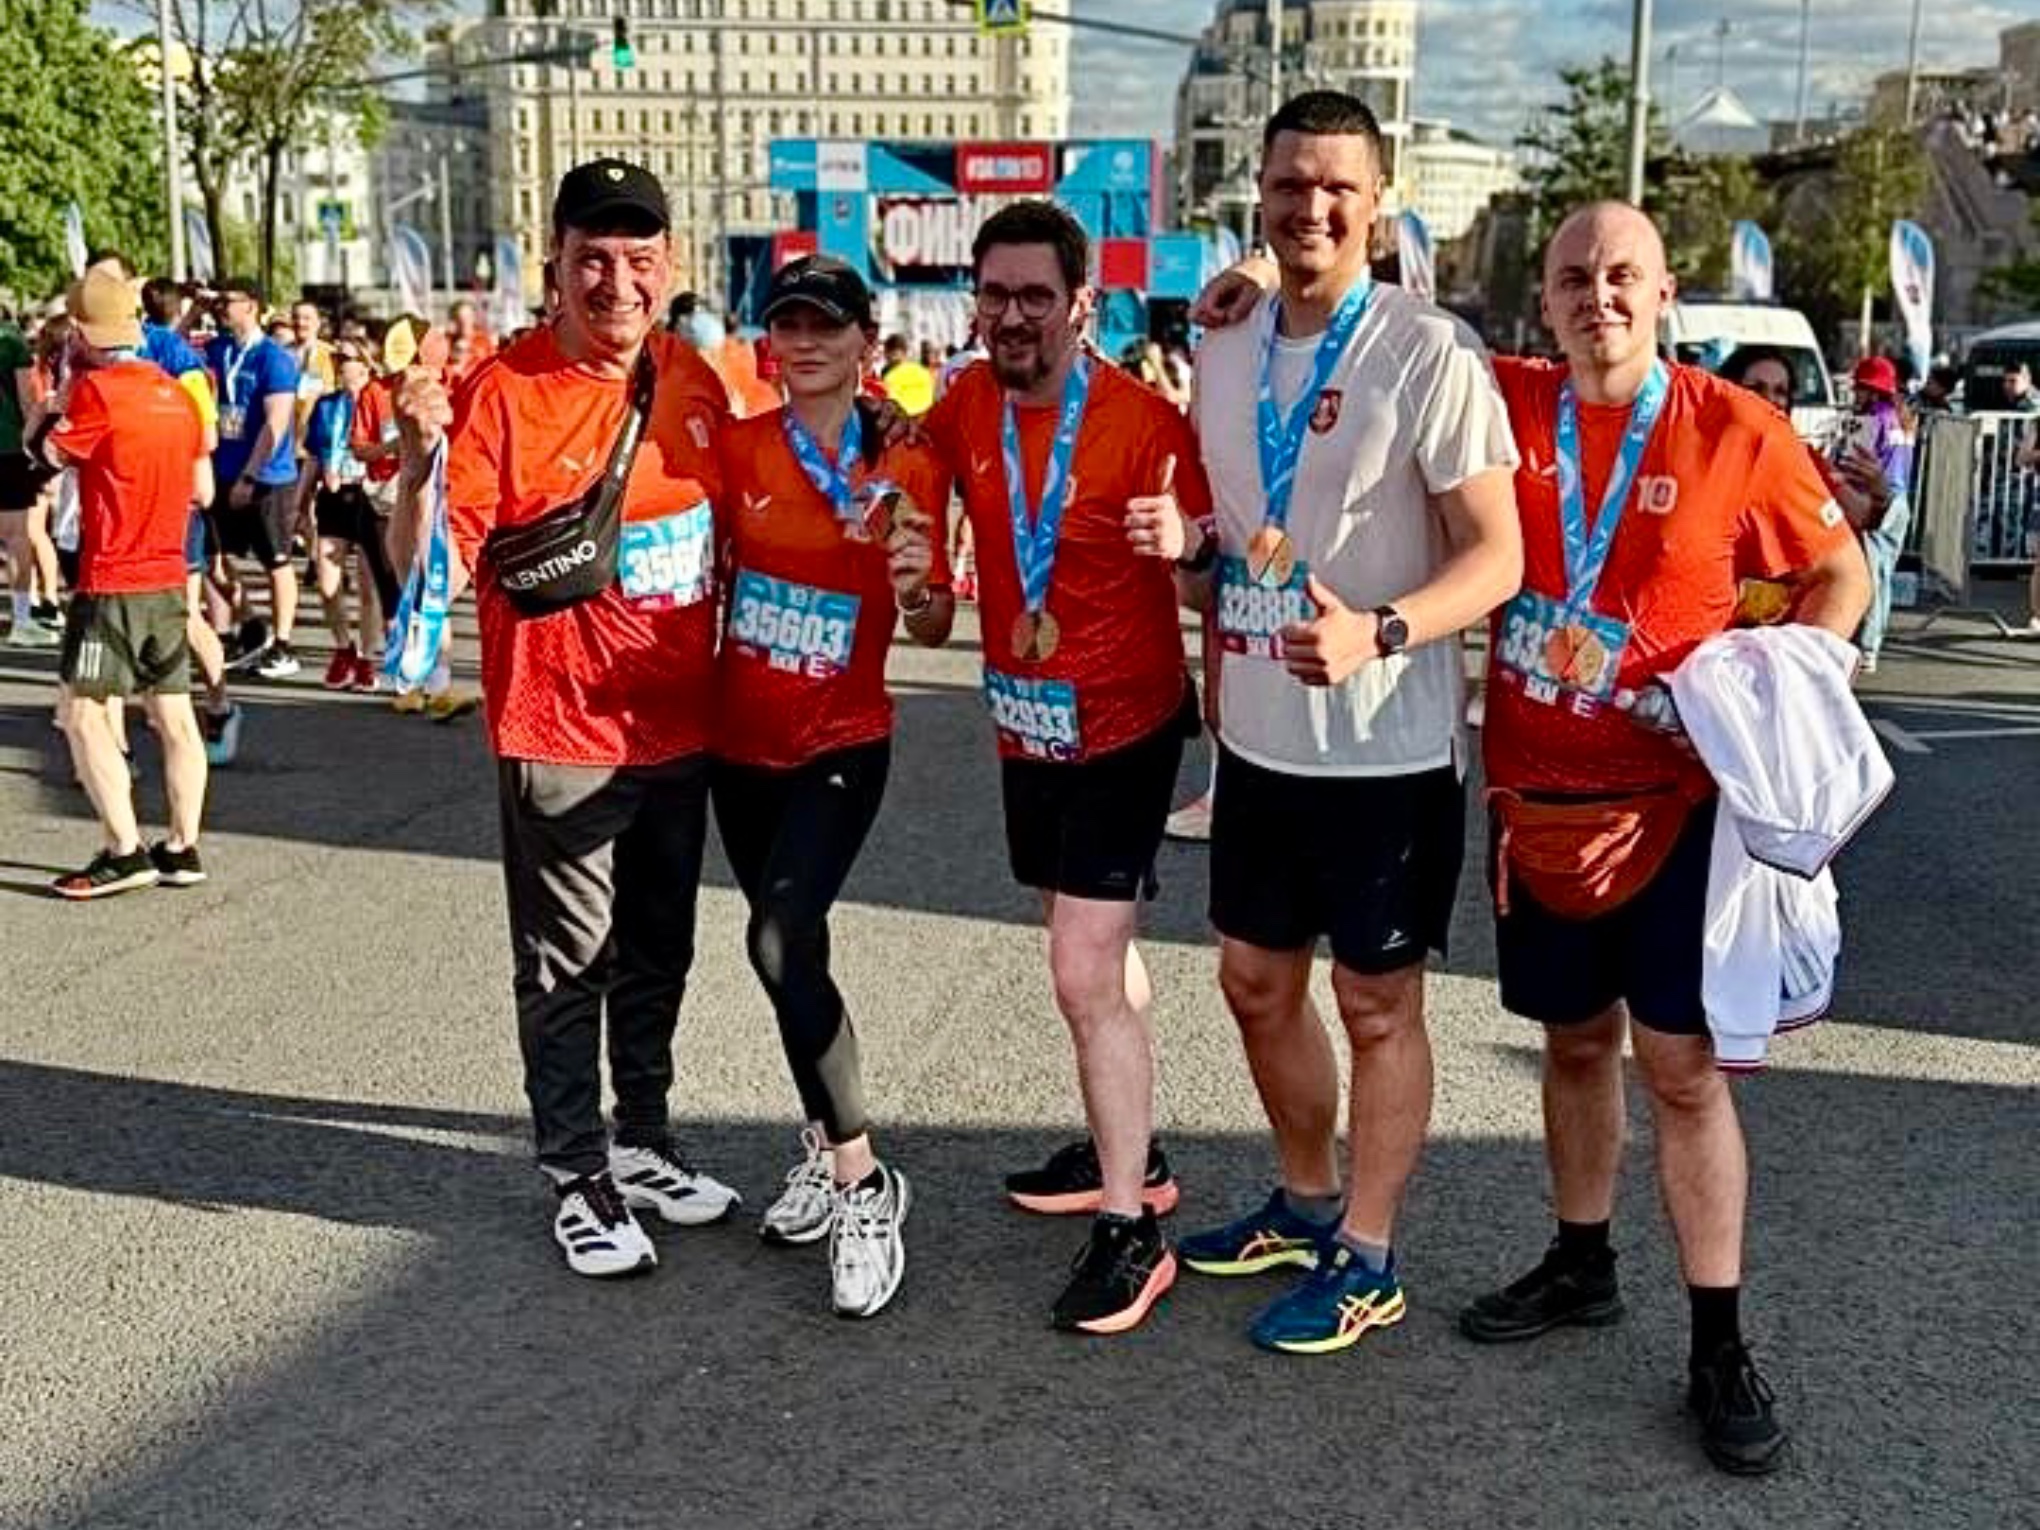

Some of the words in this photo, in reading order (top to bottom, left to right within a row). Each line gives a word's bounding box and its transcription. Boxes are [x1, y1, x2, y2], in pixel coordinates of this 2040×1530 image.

[884, 202, 976, 266] ФИН
[1637, 475, 1678, 513] 10
[736, 597, 846, 661] 35603
